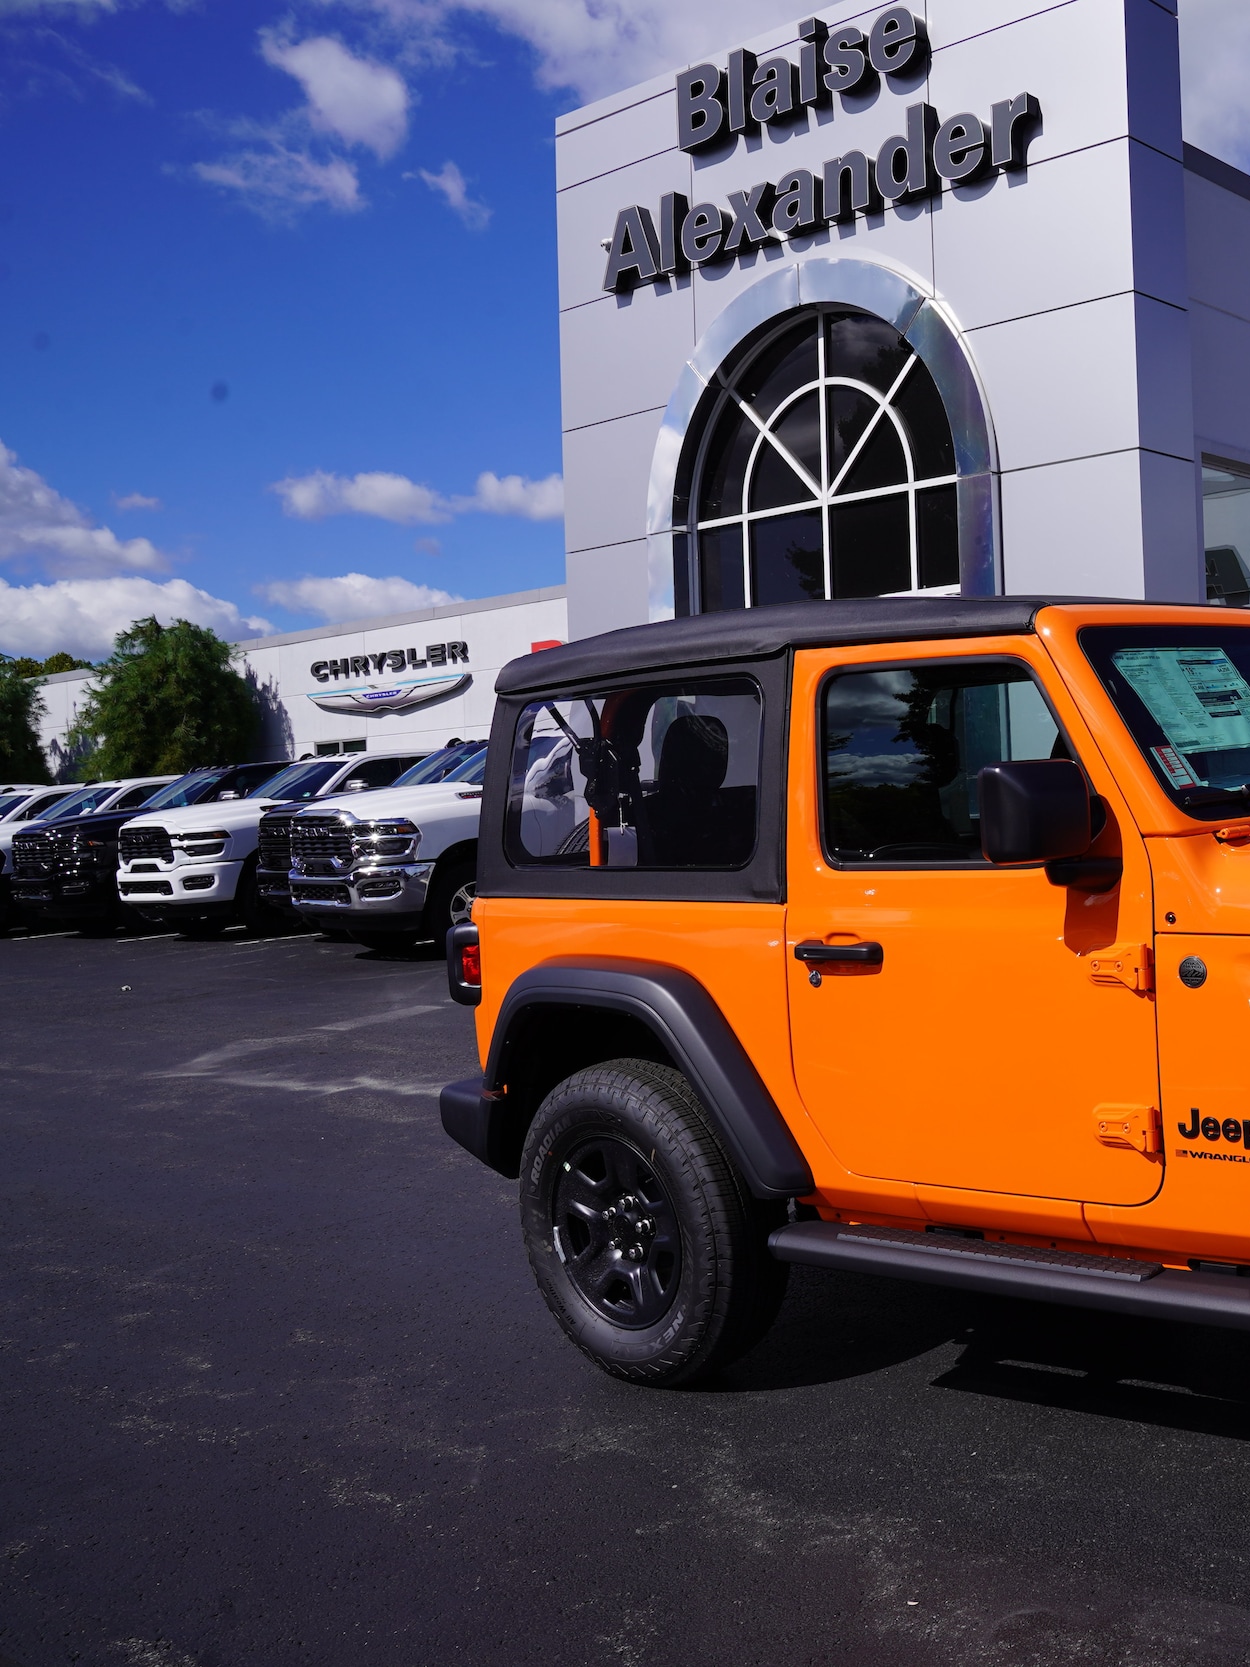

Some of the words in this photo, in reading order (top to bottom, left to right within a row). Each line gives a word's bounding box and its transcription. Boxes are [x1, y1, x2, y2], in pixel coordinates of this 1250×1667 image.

[676, 5, 927, 153] Blaise
[602, 91, 1042, 294] Alexander
[310, 641, 469, 680] CHRYSLER
[365, 690, 399, 699] CHRYSLER
[530, 1114, 574, 1186] ROADIAN
